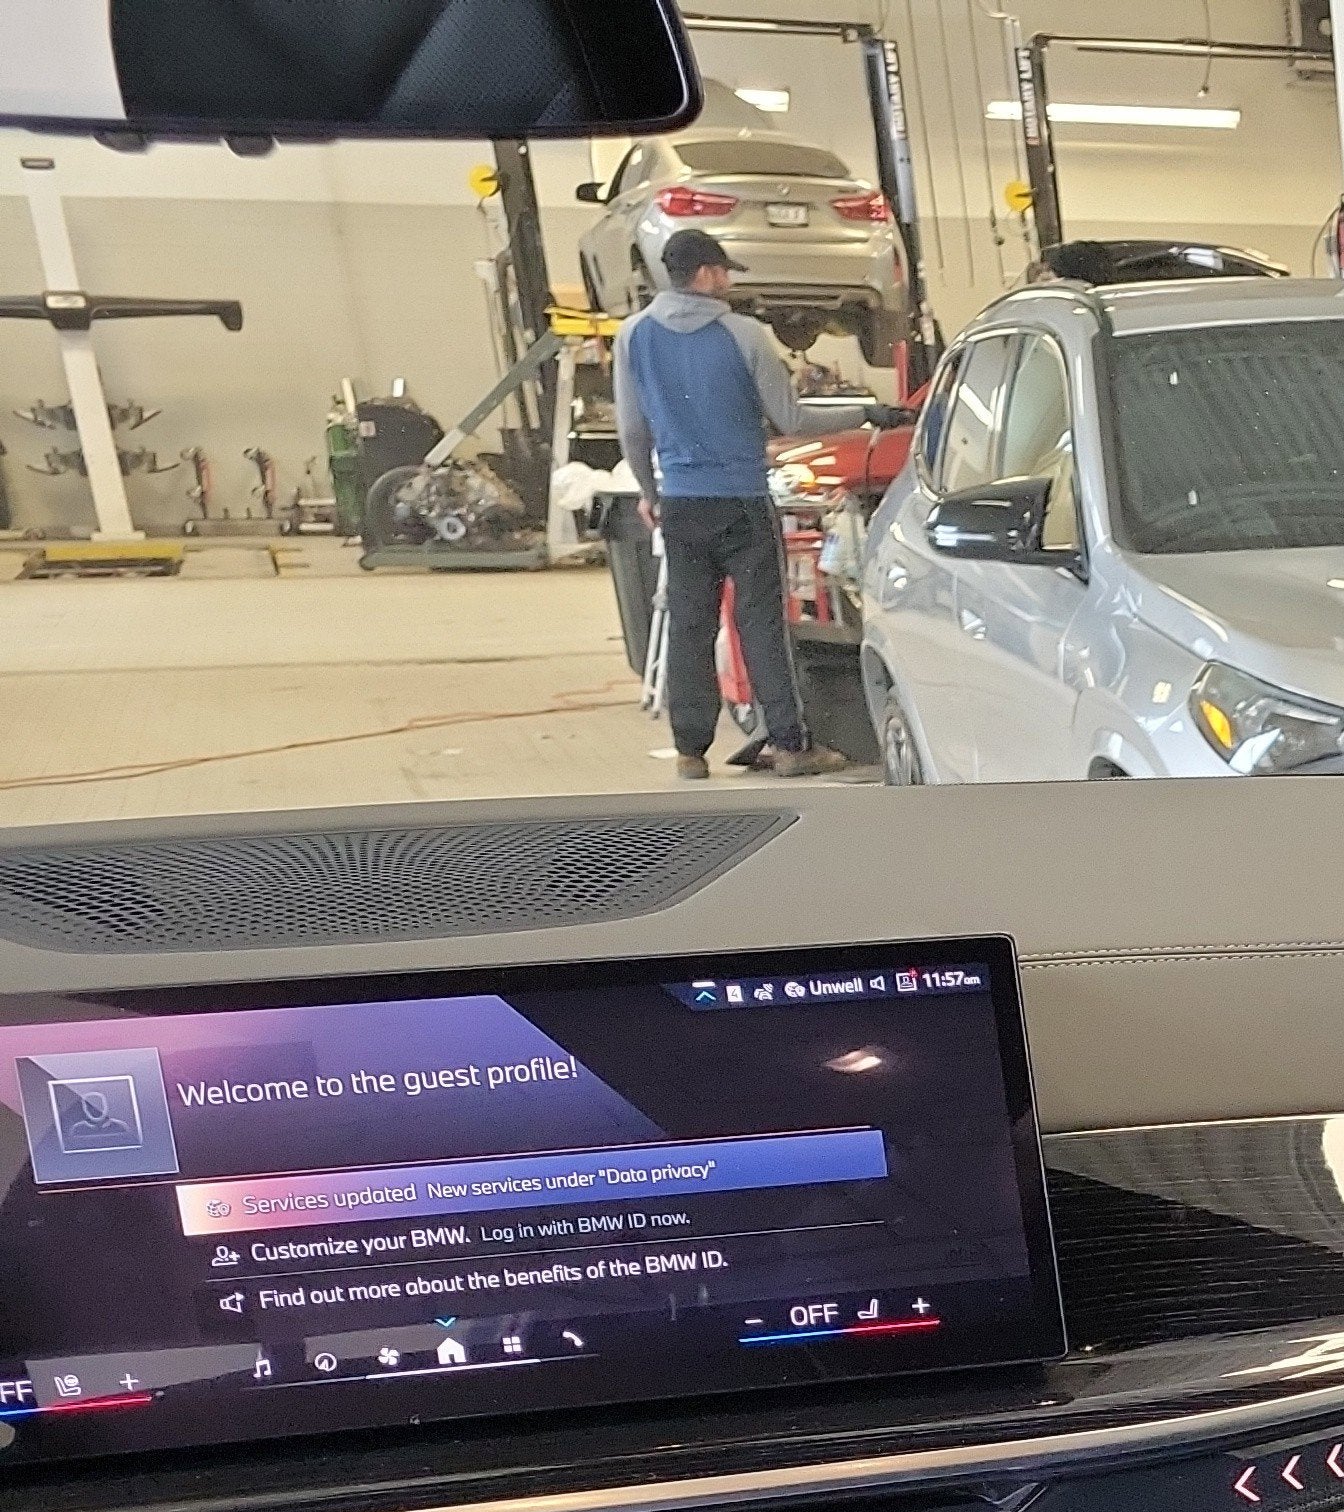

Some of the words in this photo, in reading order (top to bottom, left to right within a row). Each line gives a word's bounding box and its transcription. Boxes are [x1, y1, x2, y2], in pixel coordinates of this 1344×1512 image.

[808, 977, 864, 996] Unwell
[176, 1077, 309, 1107] Welcome
[315, 1076, 343, 1097] to
[350, 1070, 396, 1094] the
[404, 1064, 480, 1096] guest
[487, 1056, 578, 1089] profile!
[242, 1194, 329, 1215] Services
[333, 1183, 417, 1210] updated
[427, 1179, 468, 1200] New
[471, 1177, 542, 1195] services
[545, 1170, 596, 1190] under
[598, 1167, 648, 1185] "Data
[650, 1160, 716, 1183] privacy"
[251, 1236, 358, 1262] Customize
[361, 1233, 407, 1257] your
[410, 1225, 471, 1248] BMW.
[481, 1224, 514, 1243] Log
[518, 1222, 535, 1239] in
[537, 1219, 574, 1238] with
[577, 1215, 624, 1233] BMW
[628, 1212, 647, 1229] ID
[650, 1211, 691, 1227] now.
[259, 1288, 305, 1310] Find
[310, 1287, 345, 1306] out
[348, 1282, 402, 1301] more
[405, 1275, 464, 1296] about
[467, 1269, 500, 1288] the
[503, 1262, 582, 1287] benefits
[586, 1259, 607, 1279] of
[609, 1257, 642, 1278] the
[645, 1251, 697, 1274] BMW
[701, 1250, 729, 1270] ID.
[789, 1303, 839, 1326] OFF
